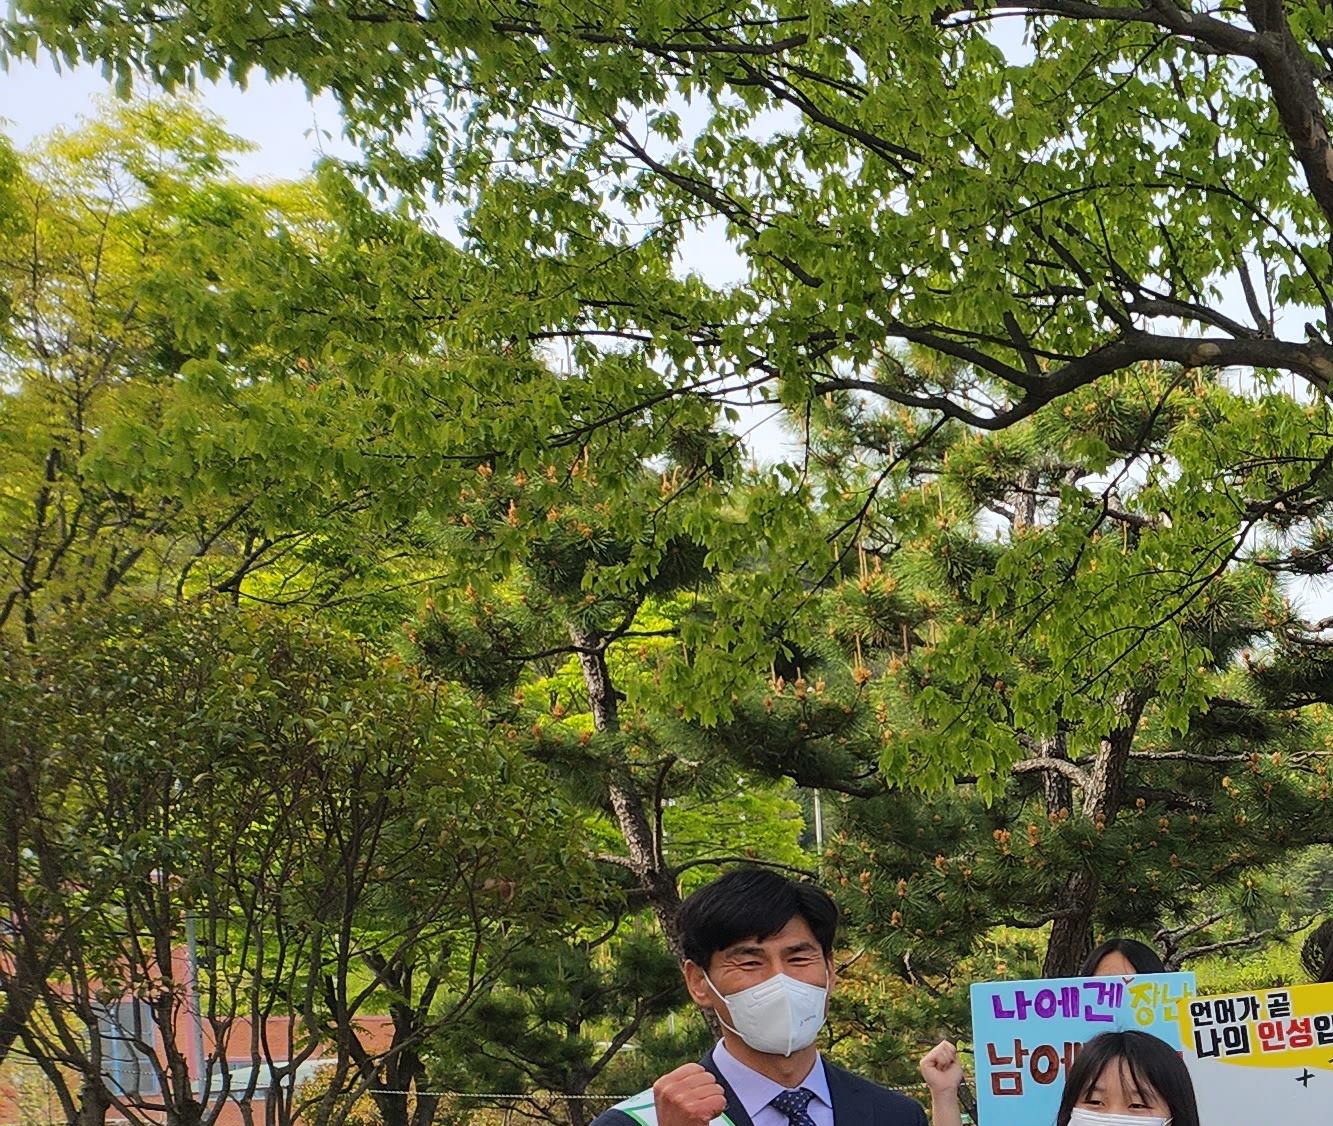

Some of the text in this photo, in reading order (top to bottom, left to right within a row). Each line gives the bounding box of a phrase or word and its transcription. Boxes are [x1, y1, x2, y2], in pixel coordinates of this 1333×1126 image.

[992, 981, 1124, 1023] 나에겐
[1190, 991, 1292, 1027] 언어가 곧
[1194, 1024, 1251, 1059] 나의
